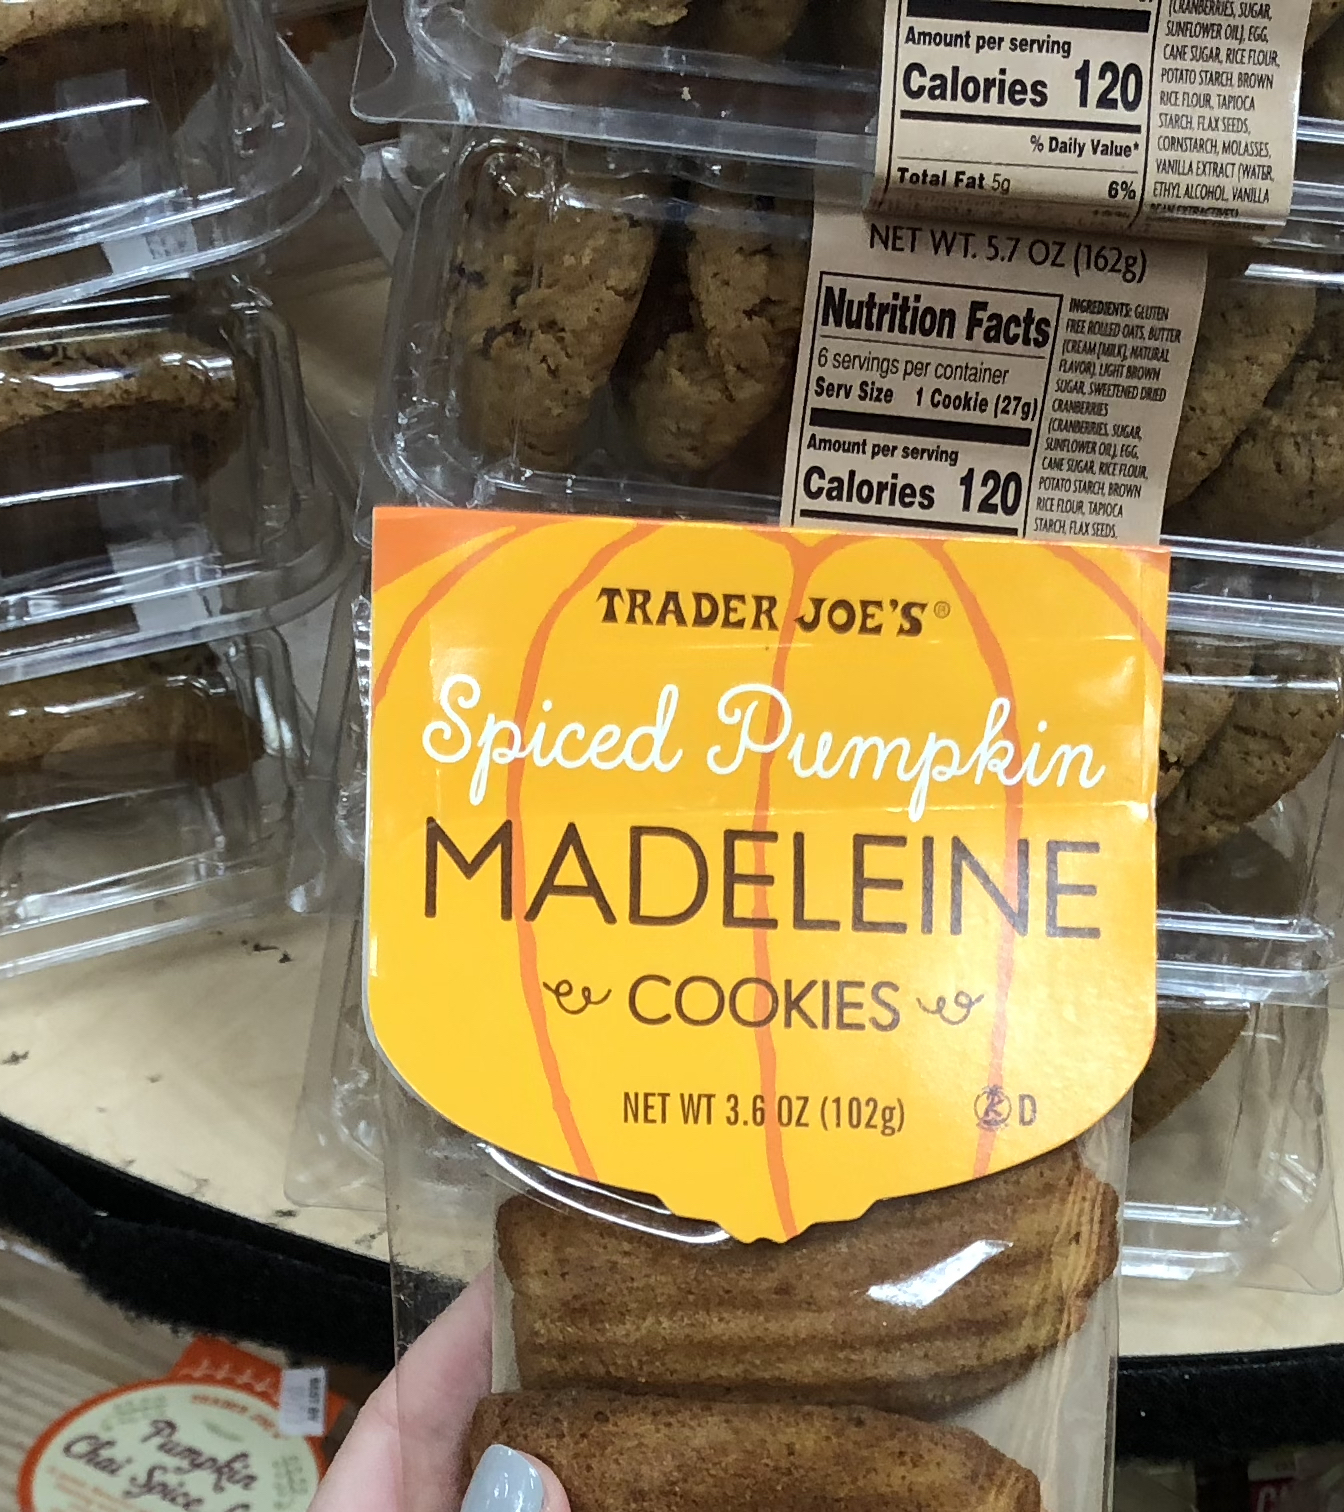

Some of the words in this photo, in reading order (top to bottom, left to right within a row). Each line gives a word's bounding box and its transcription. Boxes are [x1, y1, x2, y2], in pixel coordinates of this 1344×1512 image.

[1239, 2, 1272, 21] SUGAR,
[905, 26, 971, 49] Amount
[975, 35, 1004, 54] per
[1009, 34, 1072, 59] serving
[1165, 20, 1222, 39] SUNFLOWER
[1248, 25, 1268, 43] EGG,
[1163, 44, 1187, 61] CANE
[1190, 46, 1223, 65] SUGAR,
[1226, 48, 1245, 64] RICE
[1248, 49, 1280, 69] FLOUR,
[903, 62, 1048, 107] Calories
[1074, 59, 1143, 112] 120
[1161, 68, 1196, 83] POTATO
[1237, 73, 1274, 90] BROWN
[1160, 90, 1179, 106] RICE
[1216, 94, 1255, 110] TAPIOCA
[1159, 113, 1194, 131] STARCH,
[1197, 115, 1220, 133] FLAX
[1222, 117, 1251, 136] SEEDS,
[1030, 135, 1044, 152] %
[1048, 137, 1086, 157] Daily
[1158, 135, 1219, 156] CORNSTARCH,
[1221, 140, 1271, 159] MOLASSES,
[1156, 158, 1193, 176] VANILLA
[1196, 161, 1236, 178] EXTRACT
[897, 168, 947, 187] Total
[954, 172, 985, 189] Fat
[992, 174, 1010, 195] 5g
[1108, 180, 1137, 200] 6%
[1153, 181, 1181, 197] ETHYL
[1232, 187, 1269, 204] VANILLA
[869, 223, 922, 251] NET
[930, 230, 977, 258] WT.
[987, 235, 1020, 262] 5.7
[1028, 239, 1067, 268] OZ
[1073, 241, 1148, 285] (162g)
[821, 286, 956, 339] Nutrition
[965, 301, 1052, 348] Facts
[1134, 304, 1169, 321] GLUTEN
[1066, 318, 1086, 335] FREE
[1148, 327, 1182, 343] BUTTER
[818, 347, 828, 367] 6
[832, 351, 899, 380] servings
[903, 359, 929, 383] per
[934, 360, 1010, 384] container
[1099, 362, 1125, 378] LIGHT
[1126, 365, 1161, 381] BROWN
[814, 376, 853, 399] Serv
[857, 381, 894, 404] Size
[916, 387, 924, 407] 1
[930, 388, 989, 413] Cookie
[994, 393, 1038, 421] (27g)
[807, 433, 867, 454] Amount
[871, 442, 897, 459] per
[901, 443, 959, 467] serving
[1099, 461, 1118, 477] RICE
[803, 465, 935, 510] Calories
[959, 467, 1022, 517] 120
[1039, 476, 1071, 492] POTATO
[1108, 482, 1141, 498] BROWN
[1036, 497, 1054, 511] RICE
[1088, 501, 1123, 518] TAPIOCA
[1070, 520, 1090, 536] FLAX
[596, 587, 779, 631] TRADER
[422, 673, 683, 807] Spiced
[707, 682, 1105, 823] Pumpkin
[424, 815, 1102, 941] MADELEINE
[626, 974, 902, 1033] COOKIES
[623, 1091, 670, 1125] NET
[679, 1093, 716, 1126] WT
[726, 1095, 765, 1127] 3.6
[778, 1095, 809, 1129] OZ
[820, 1096, 905, 1137] (102g)
[1018, 1094, 1037, 1126] D
[142, 1420, 258, 1492] Pumpkin
[64, 1434, 131, 1477] Chai
[123, 1467, 205, 1511] Spice
